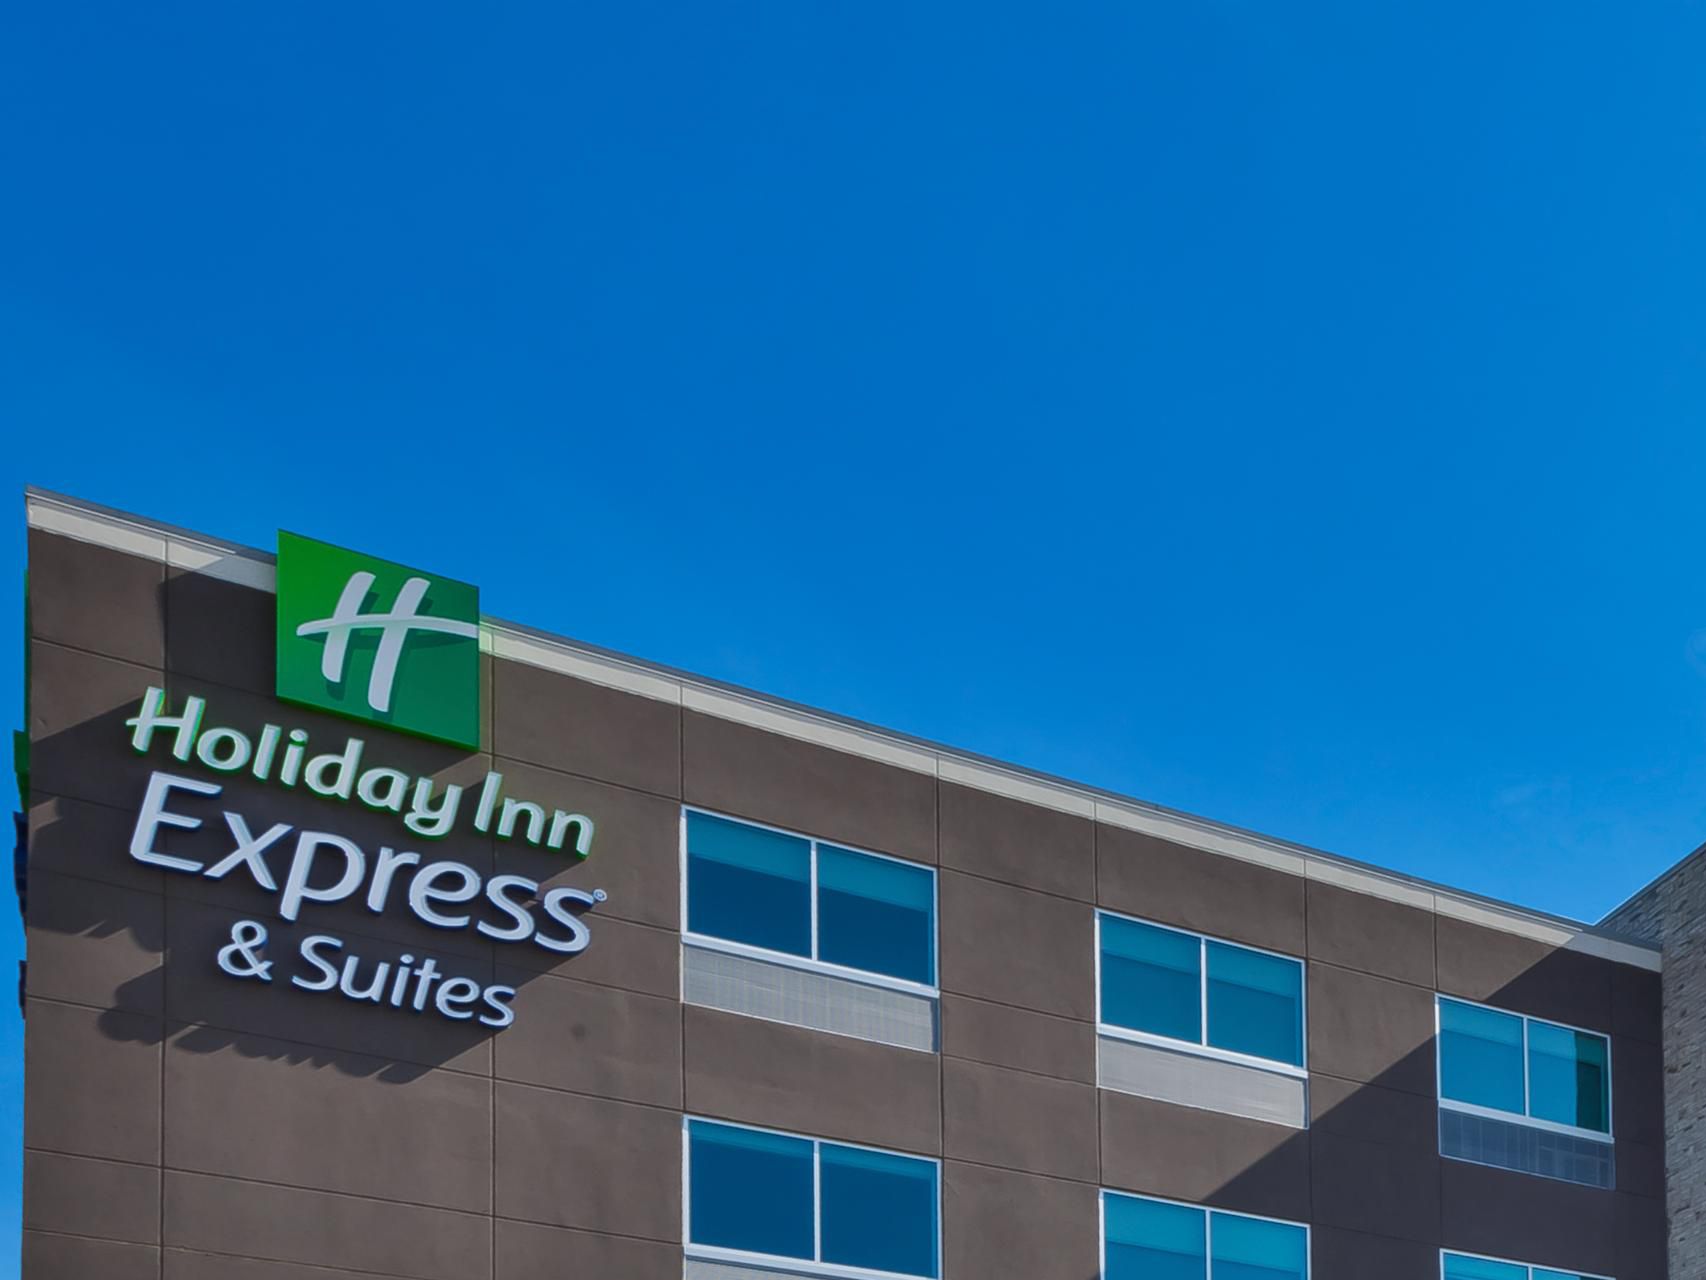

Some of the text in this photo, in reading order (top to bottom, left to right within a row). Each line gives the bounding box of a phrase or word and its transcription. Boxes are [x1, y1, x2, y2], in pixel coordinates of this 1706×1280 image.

[126, 686, 596, 859] Holiday Inn
[217, 920, 517, 1028] & Suites
